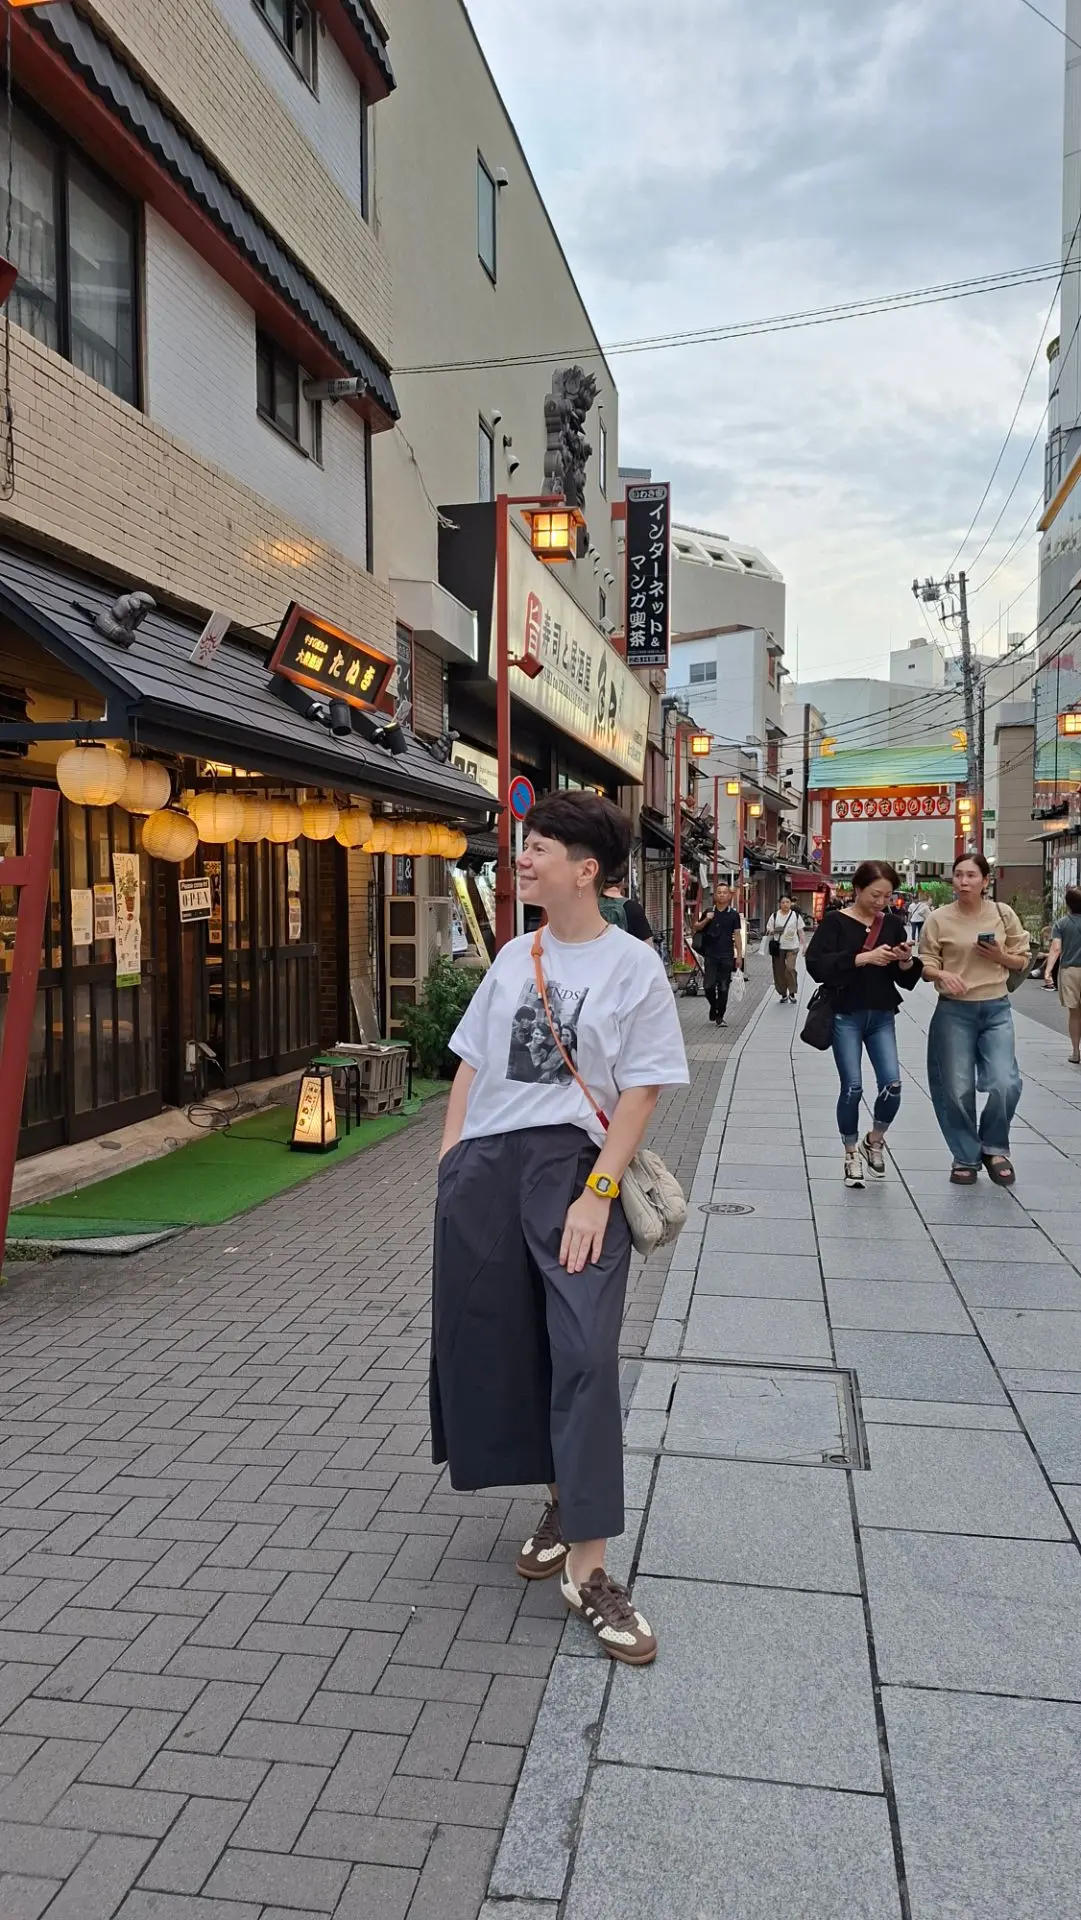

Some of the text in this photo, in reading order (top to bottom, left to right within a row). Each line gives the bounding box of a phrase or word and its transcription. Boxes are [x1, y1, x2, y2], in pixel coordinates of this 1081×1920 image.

[629, 555, 647, 648] マンガ喫茶
[648, 503, 665, 647] インターネット&
[328, 649, 376, 692] たぬき
[182, 891, 209, 907] OPEN
